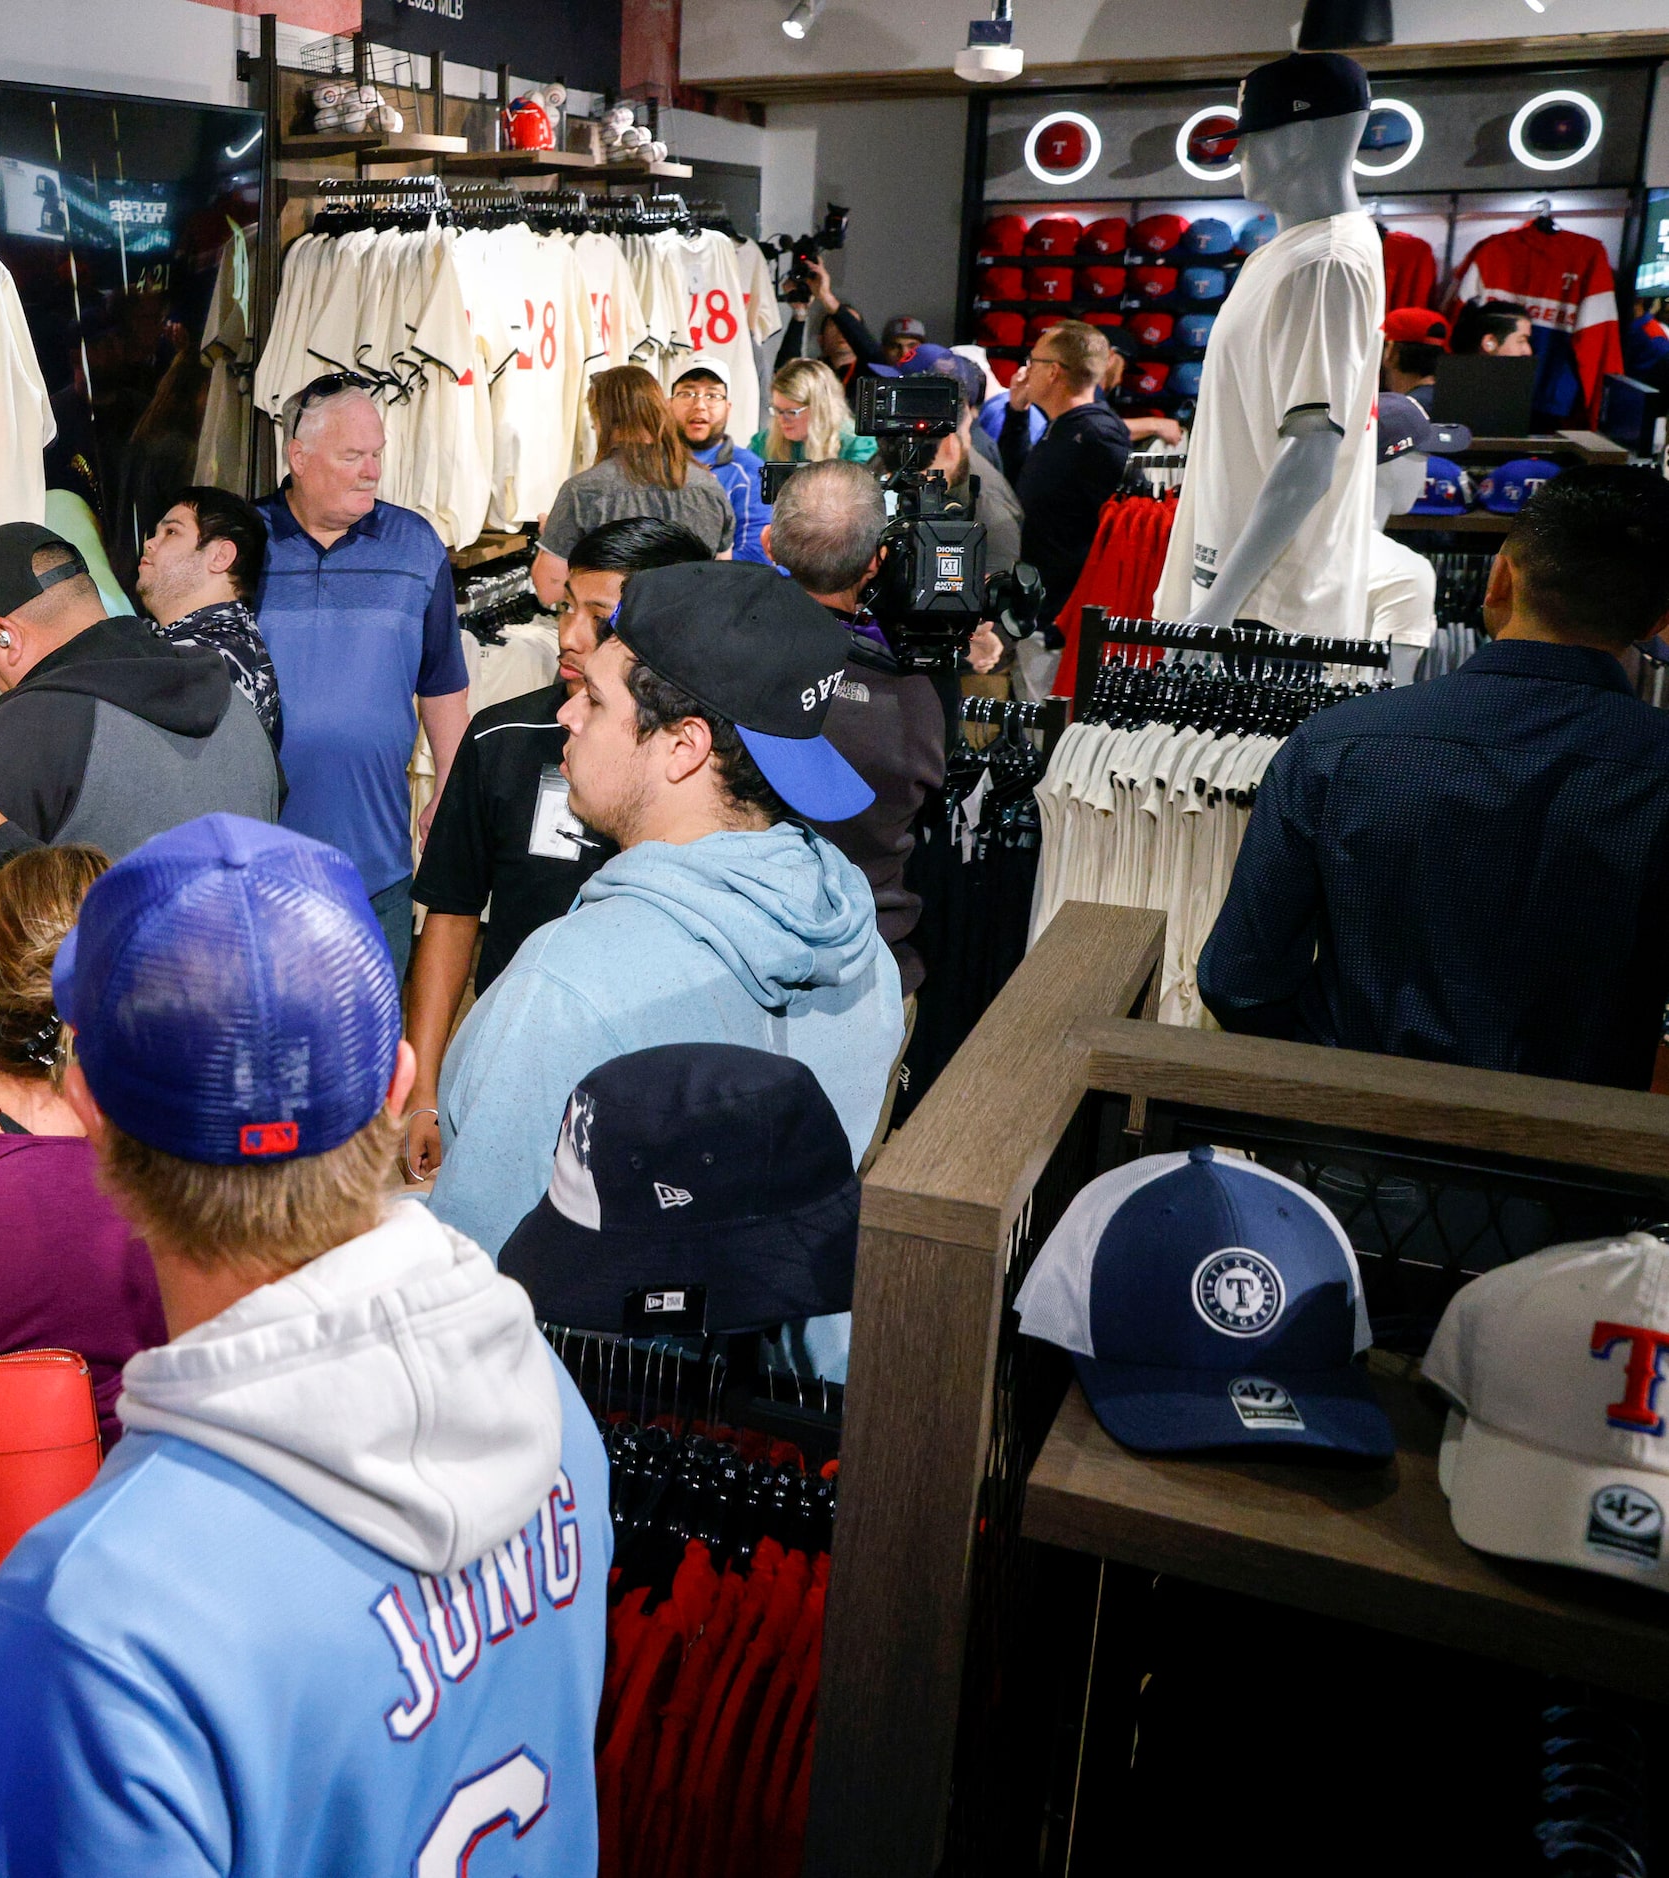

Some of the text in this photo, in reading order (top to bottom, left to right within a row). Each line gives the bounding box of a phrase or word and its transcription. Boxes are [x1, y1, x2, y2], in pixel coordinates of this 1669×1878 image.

[437, 0, 463, 20] MLB
[944, 561, 955, 569] XT
[836, 691, 858, 700] FACE
[1210, 1258, 1264, 1278] TEXAS
[1226, 1278, 1254, 1308] T
[1206, 1297, 1273, 1326] RANGERS
[1590, 1320, 1669, 1437] T
[725, 1468, 736, 1480] 3X
[368, 1466, 582, 1743] JUNG
